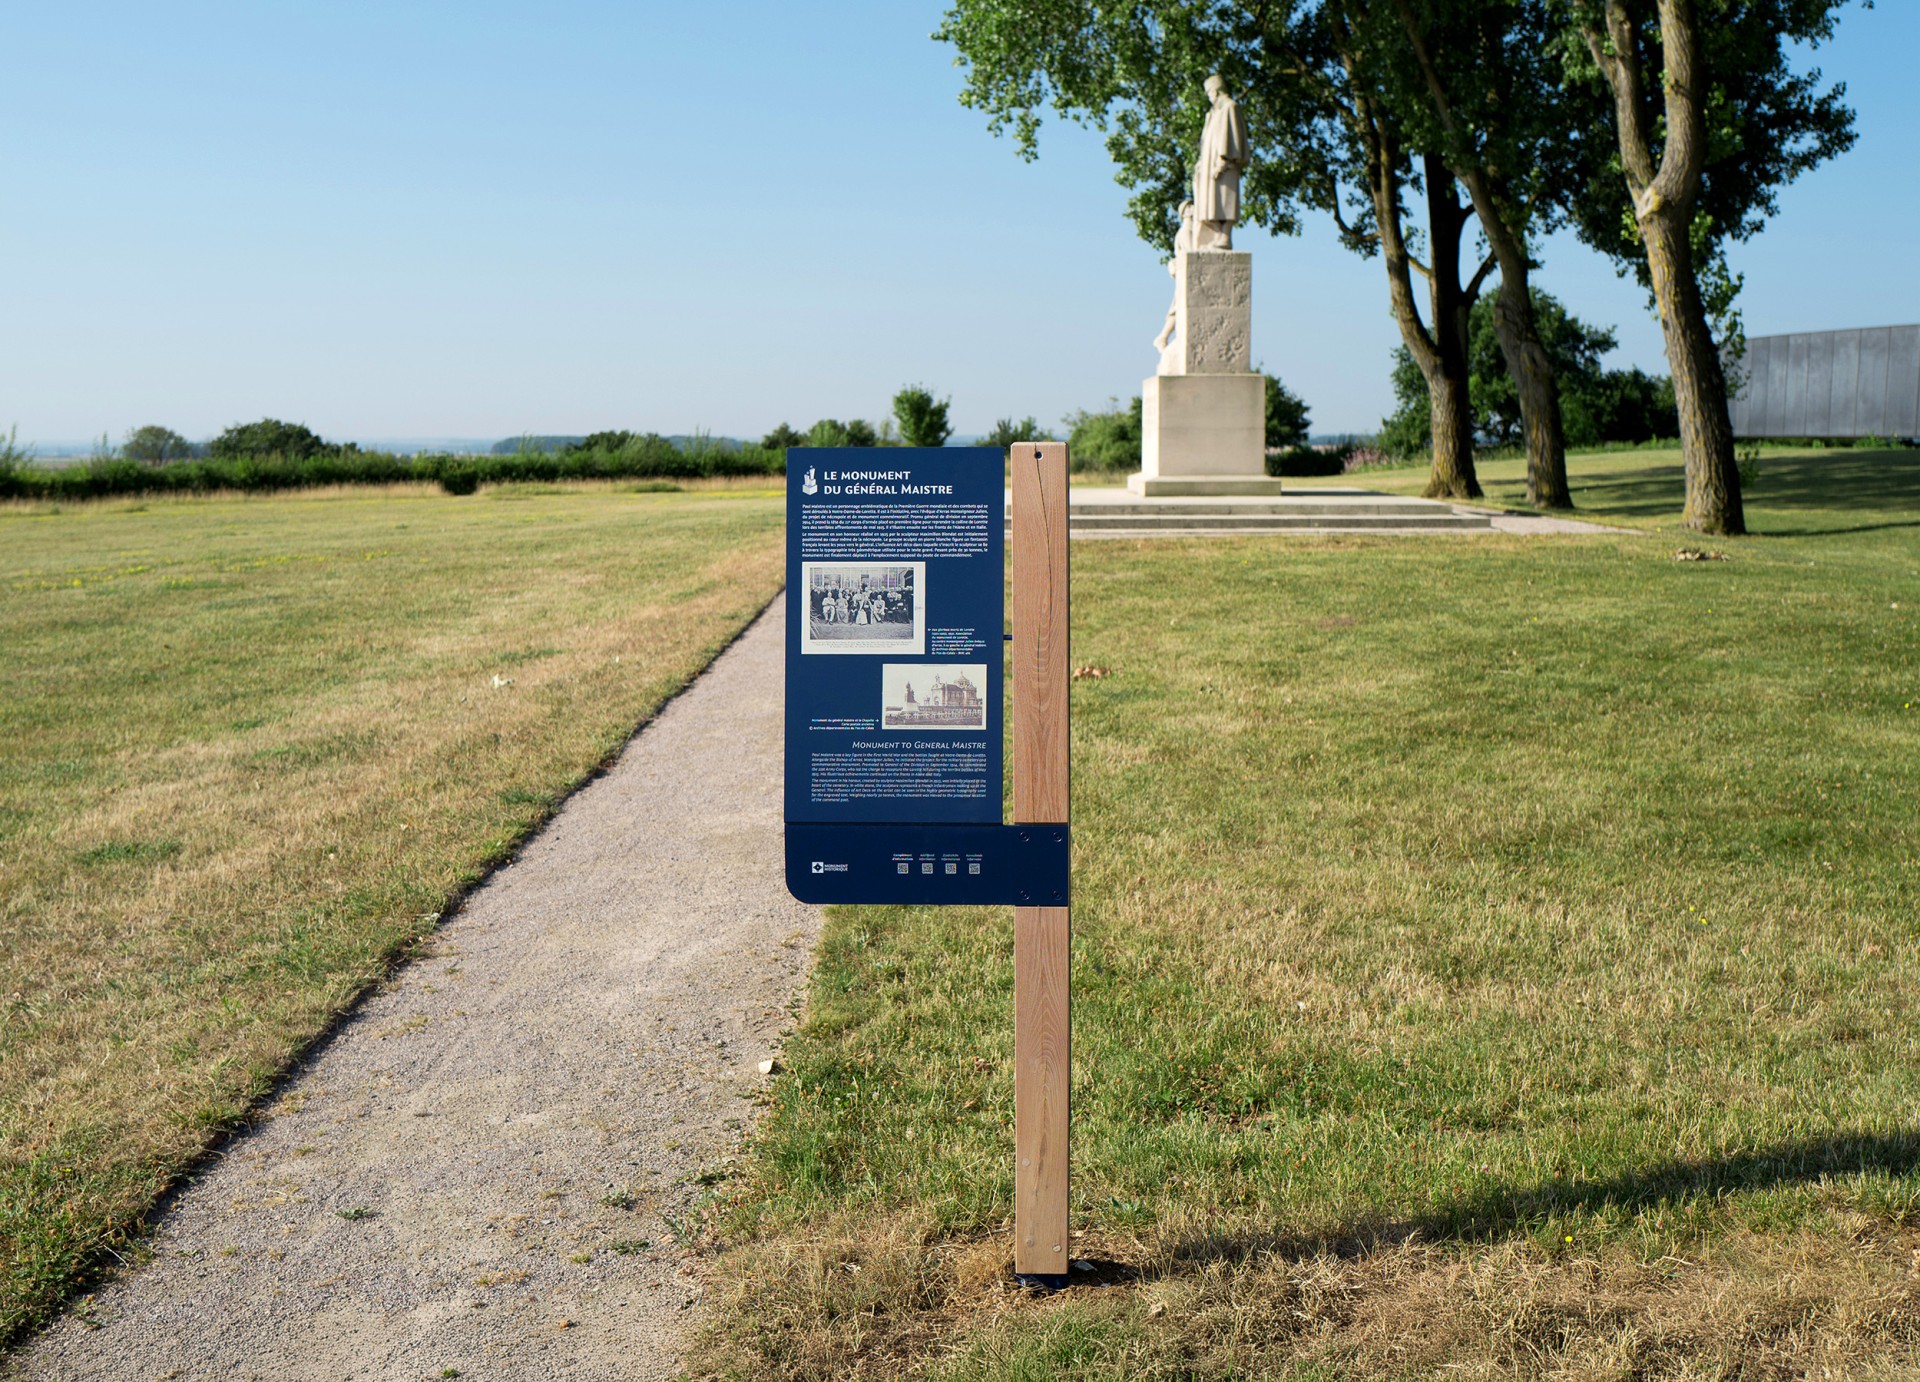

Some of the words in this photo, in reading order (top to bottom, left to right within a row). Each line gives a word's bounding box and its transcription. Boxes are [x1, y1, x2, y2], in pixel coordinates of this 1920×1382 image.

[824, 471, 837, 480] LE
[841, 471, 911, 480] MONUMENT
[824, 485, 841, 494] DU
[845, 483, 897, 494] GÉNÉRAL
[901, 484, 953, 494] MAISTRE
